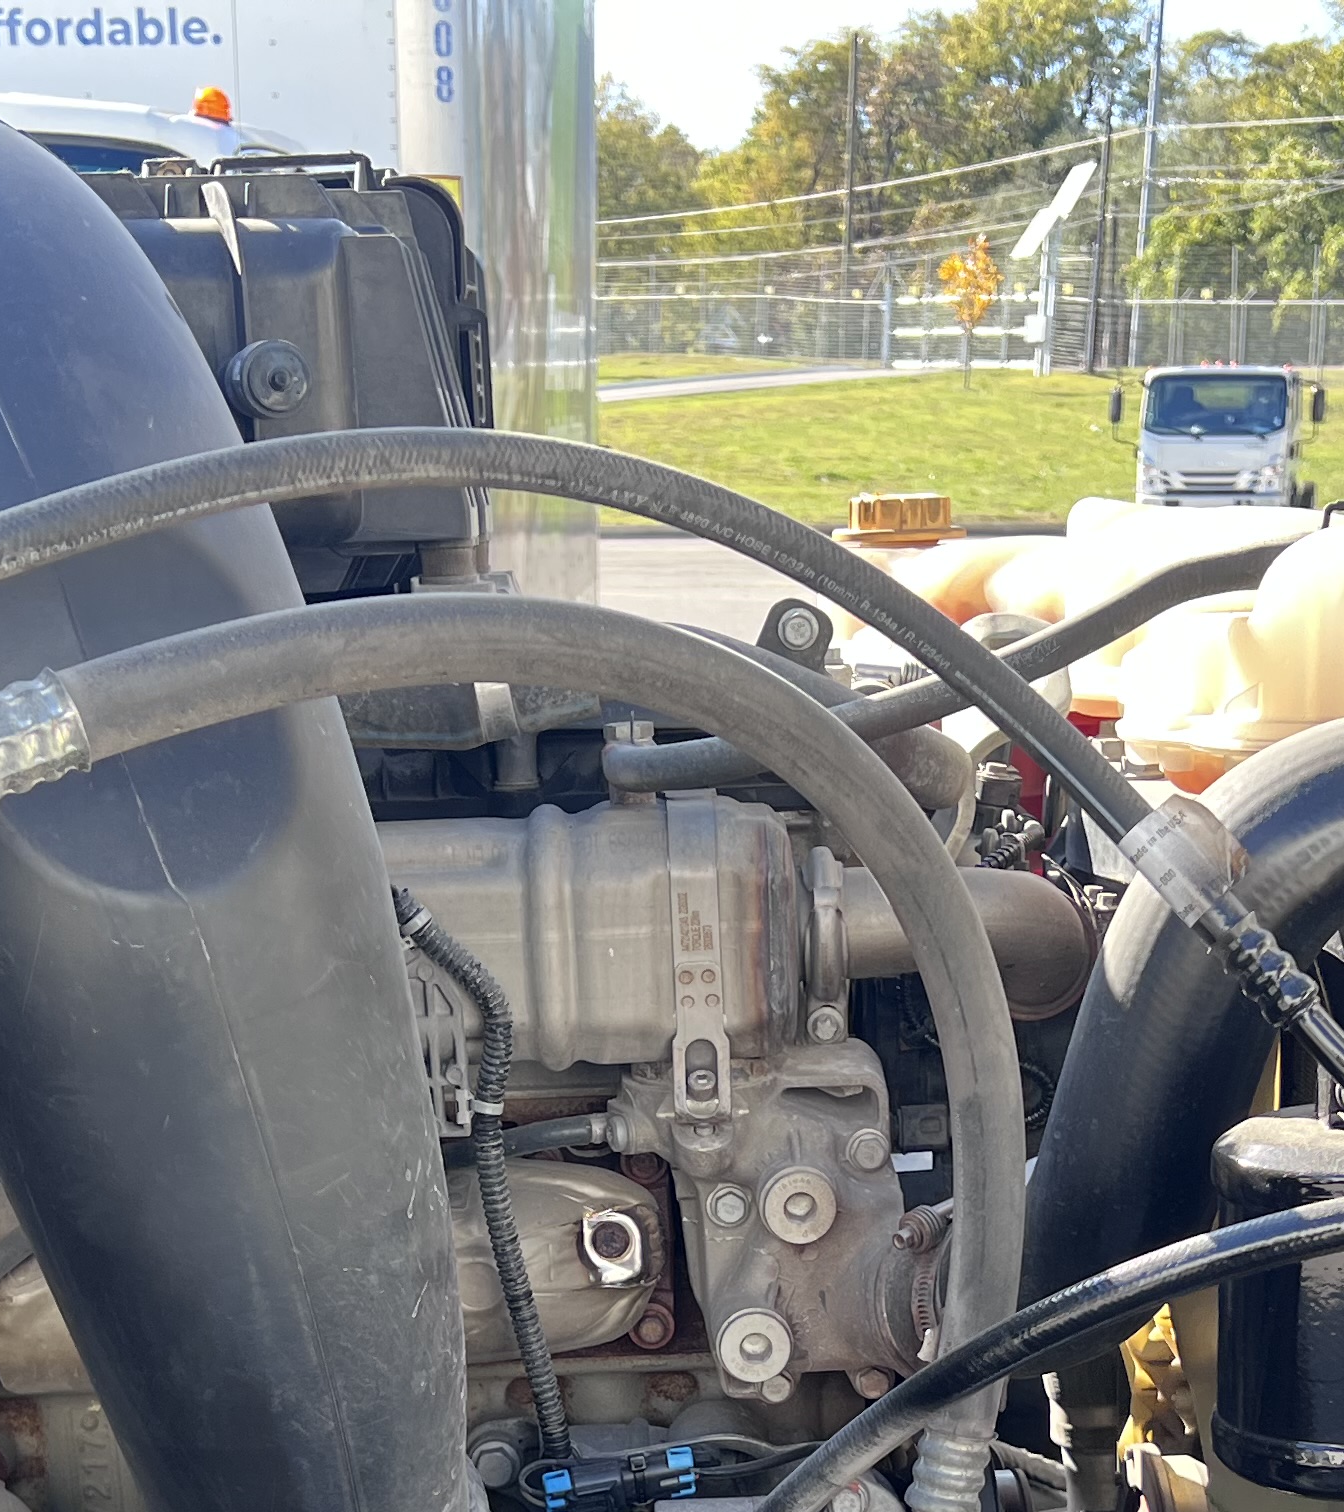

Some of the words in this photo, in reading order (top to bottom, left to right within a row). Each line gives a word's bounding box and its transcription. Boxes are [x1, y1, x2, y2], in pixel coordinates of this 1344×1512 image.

[711, 523, 735, 539] A/C
[734, 532, 773, 556] HOSE
[773, 550, 805, 572] 13/32
[1167, 810, 1188, 828] USA
